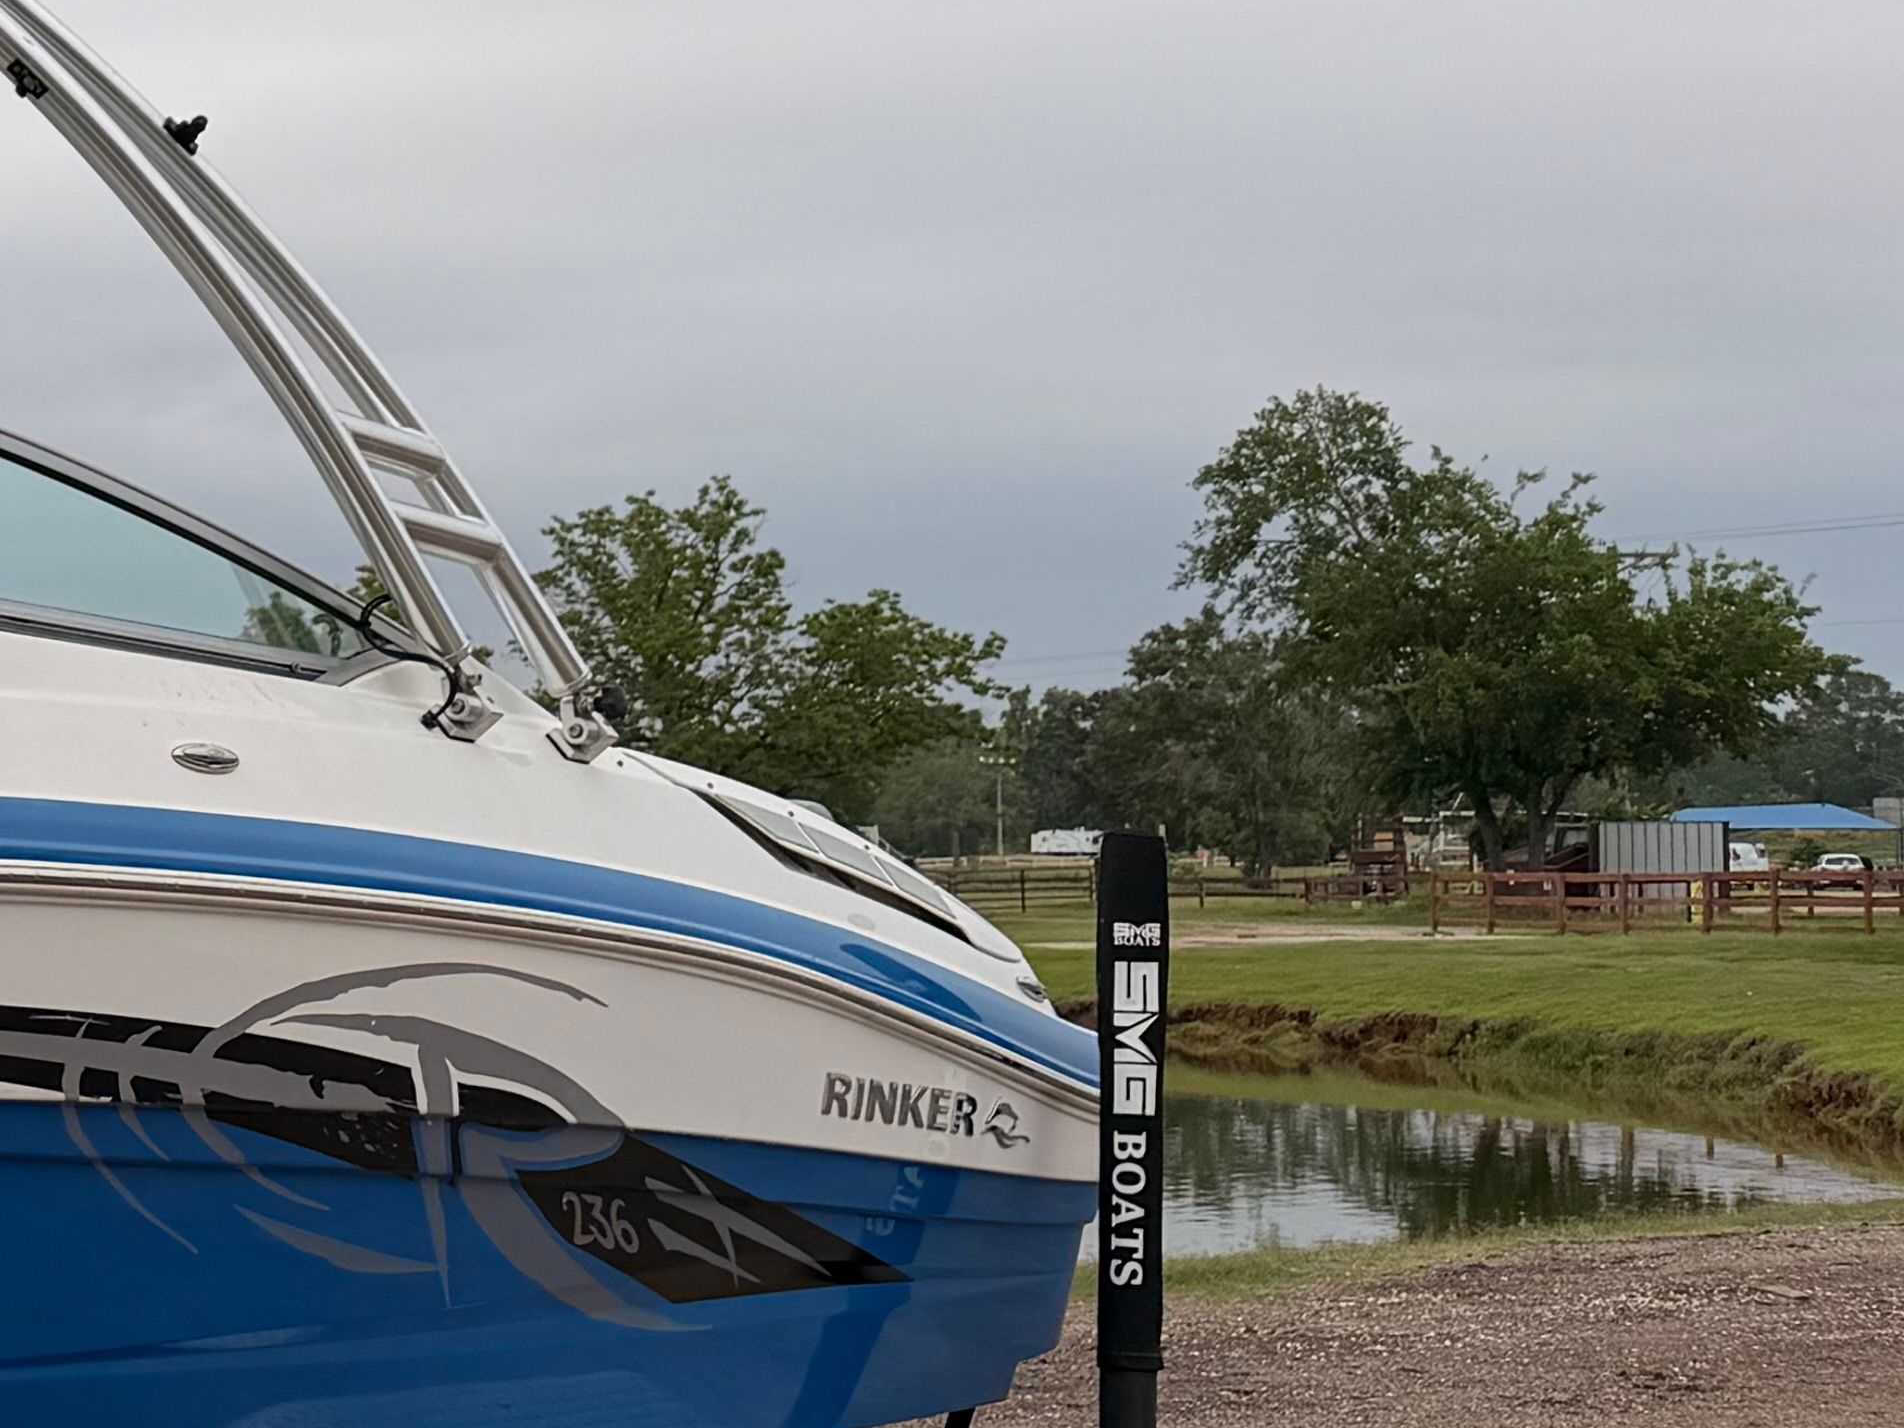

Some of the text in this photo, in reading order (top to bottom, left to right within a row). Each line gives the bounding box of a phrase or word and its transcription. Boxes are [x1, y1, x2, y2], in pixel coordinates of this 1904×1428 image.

[1113, 922, 1161, 939] SMG
[1114, 935, 1161, 947] BOATS
[821, 1072, 977, 1137] RINKER
[1109, 961, 1160, 1286] SMG BOATS
[562, 1191, 639, 1253] 236
